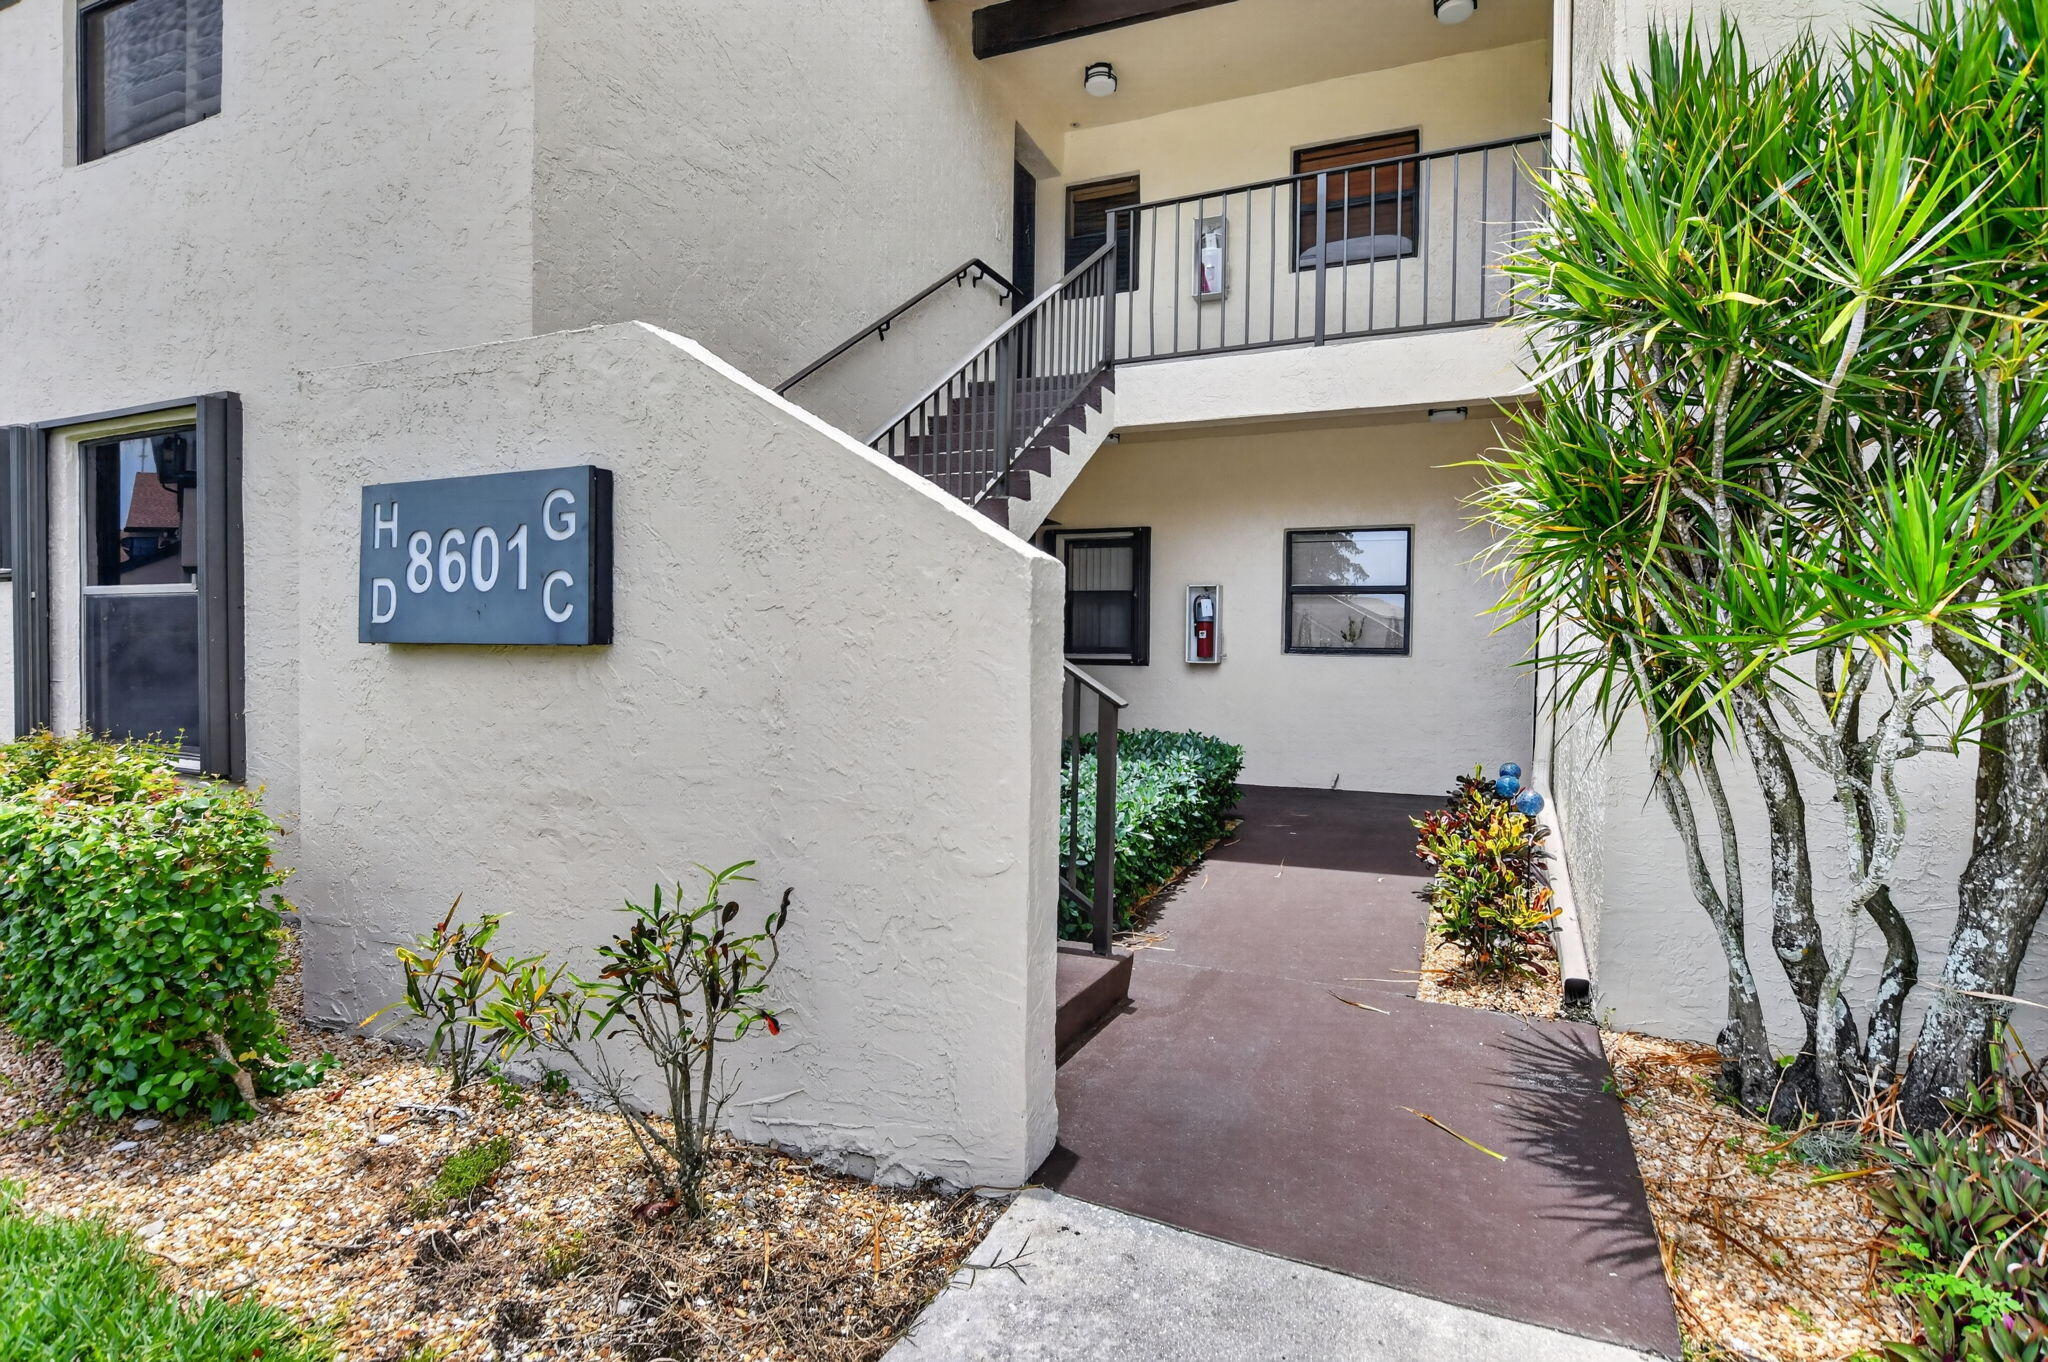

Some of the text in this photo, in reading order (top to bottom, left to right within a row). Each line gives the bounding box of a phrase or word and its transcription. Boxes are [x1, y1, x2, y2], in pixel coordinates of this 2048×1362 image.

[374, 502, 398, 549] H
[543, 488, 575, 541] G
[406, 524, 528, 594] 8601
[371, 578, 397, 624] D
[543, 571, 574, 623] C
